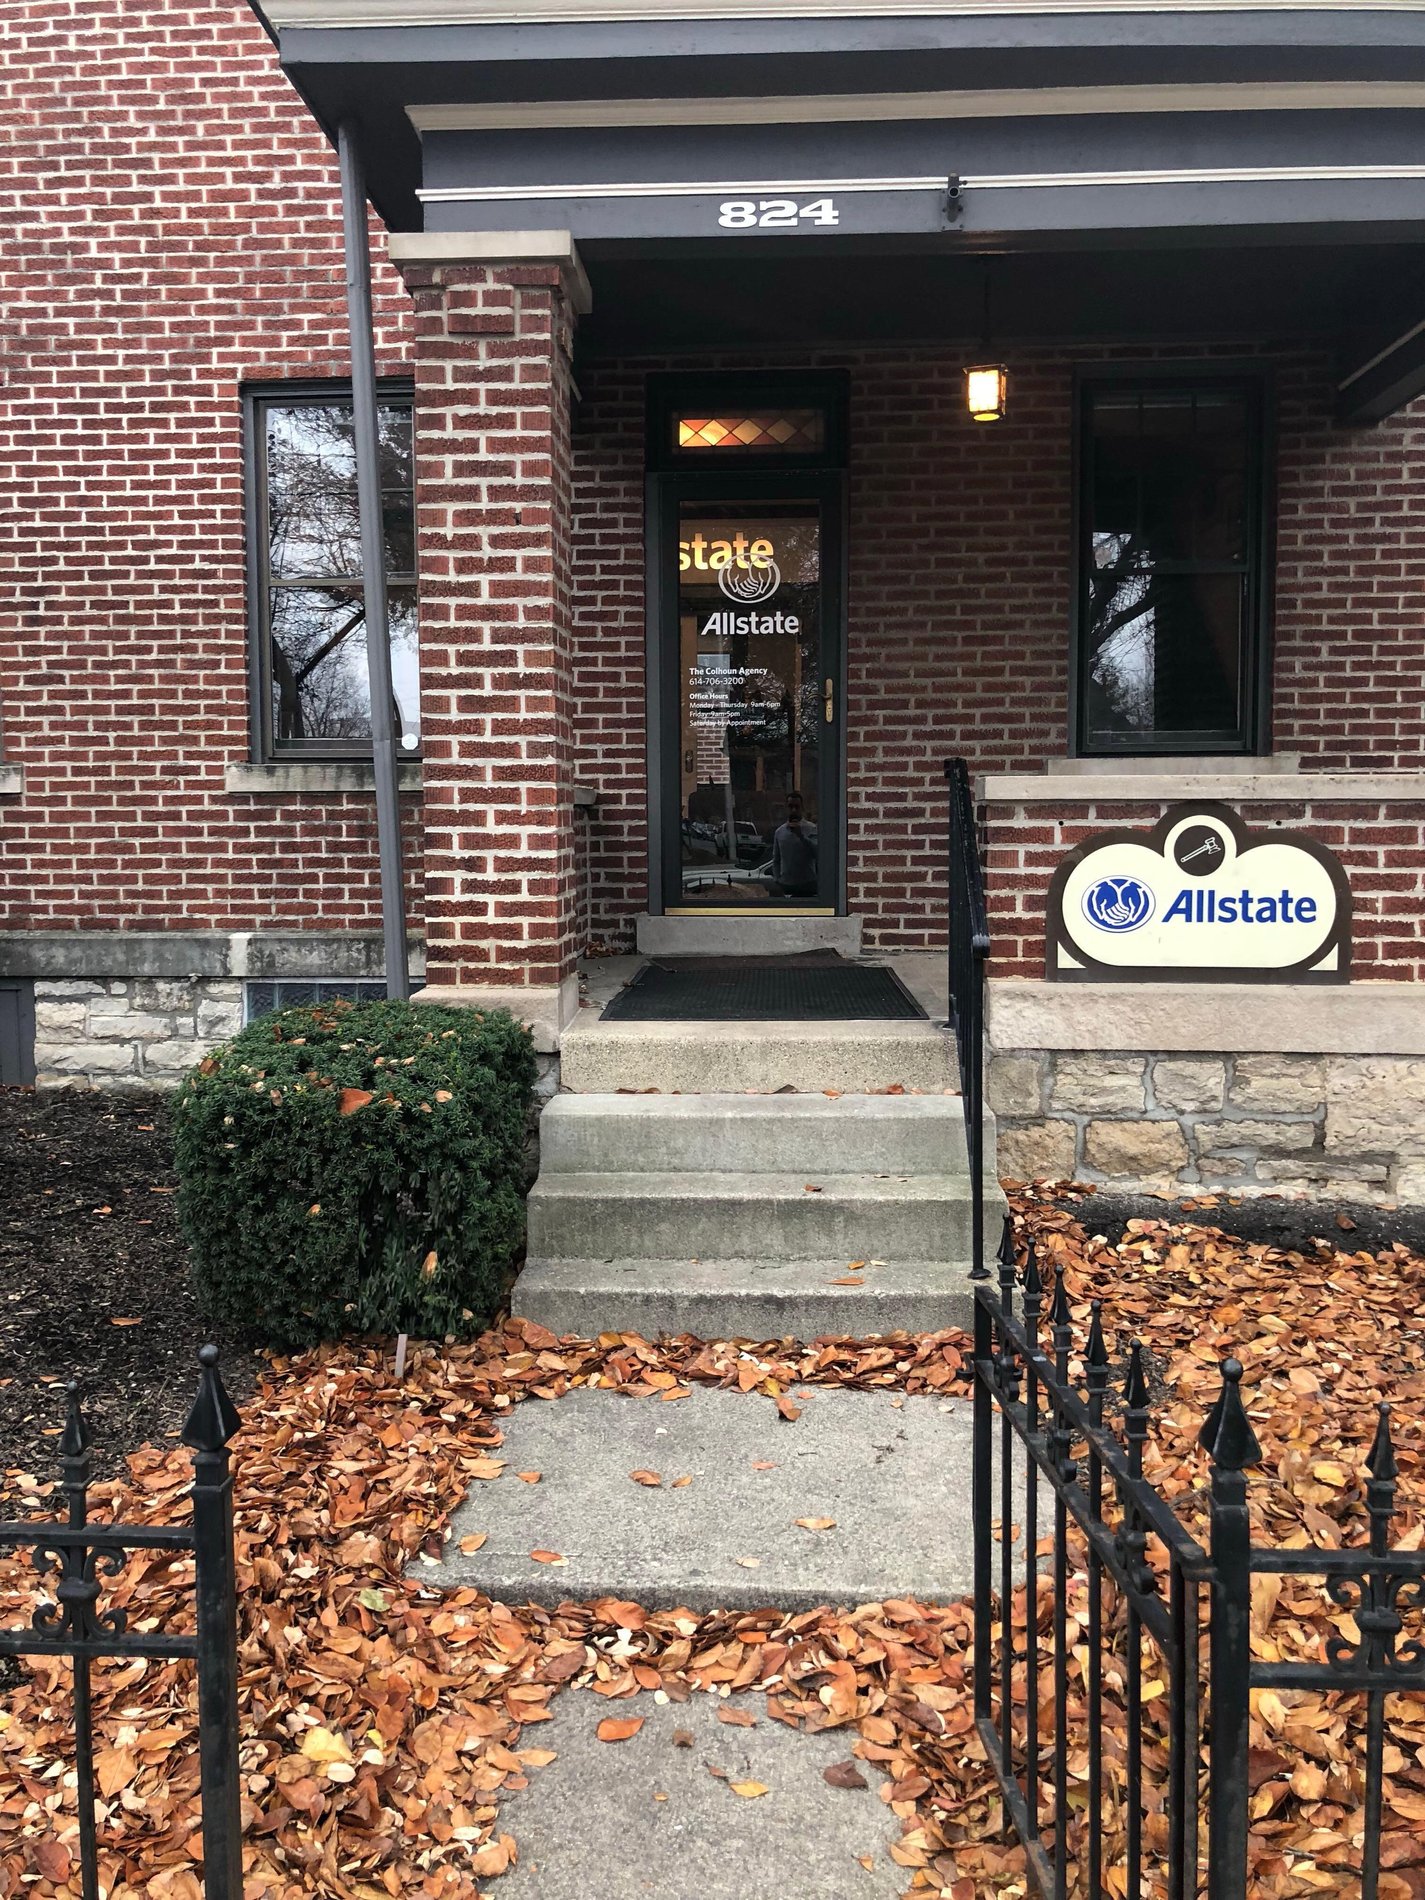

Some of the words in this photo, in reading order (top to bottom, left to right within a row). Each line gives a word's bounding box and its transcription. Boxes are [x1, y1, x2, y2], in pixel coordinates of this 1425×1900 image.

[718, 199, 839, 228] 824
[701, 611, 799, 635] Allstate
[689, 667, 704, 675] The
[705, 667, 737, 675] Colhoun
[739, 667, 768, 675] Agency
[689, 677, 744, 685] 614-706-3200
[1162, 889, 1317, 923] Allstate
